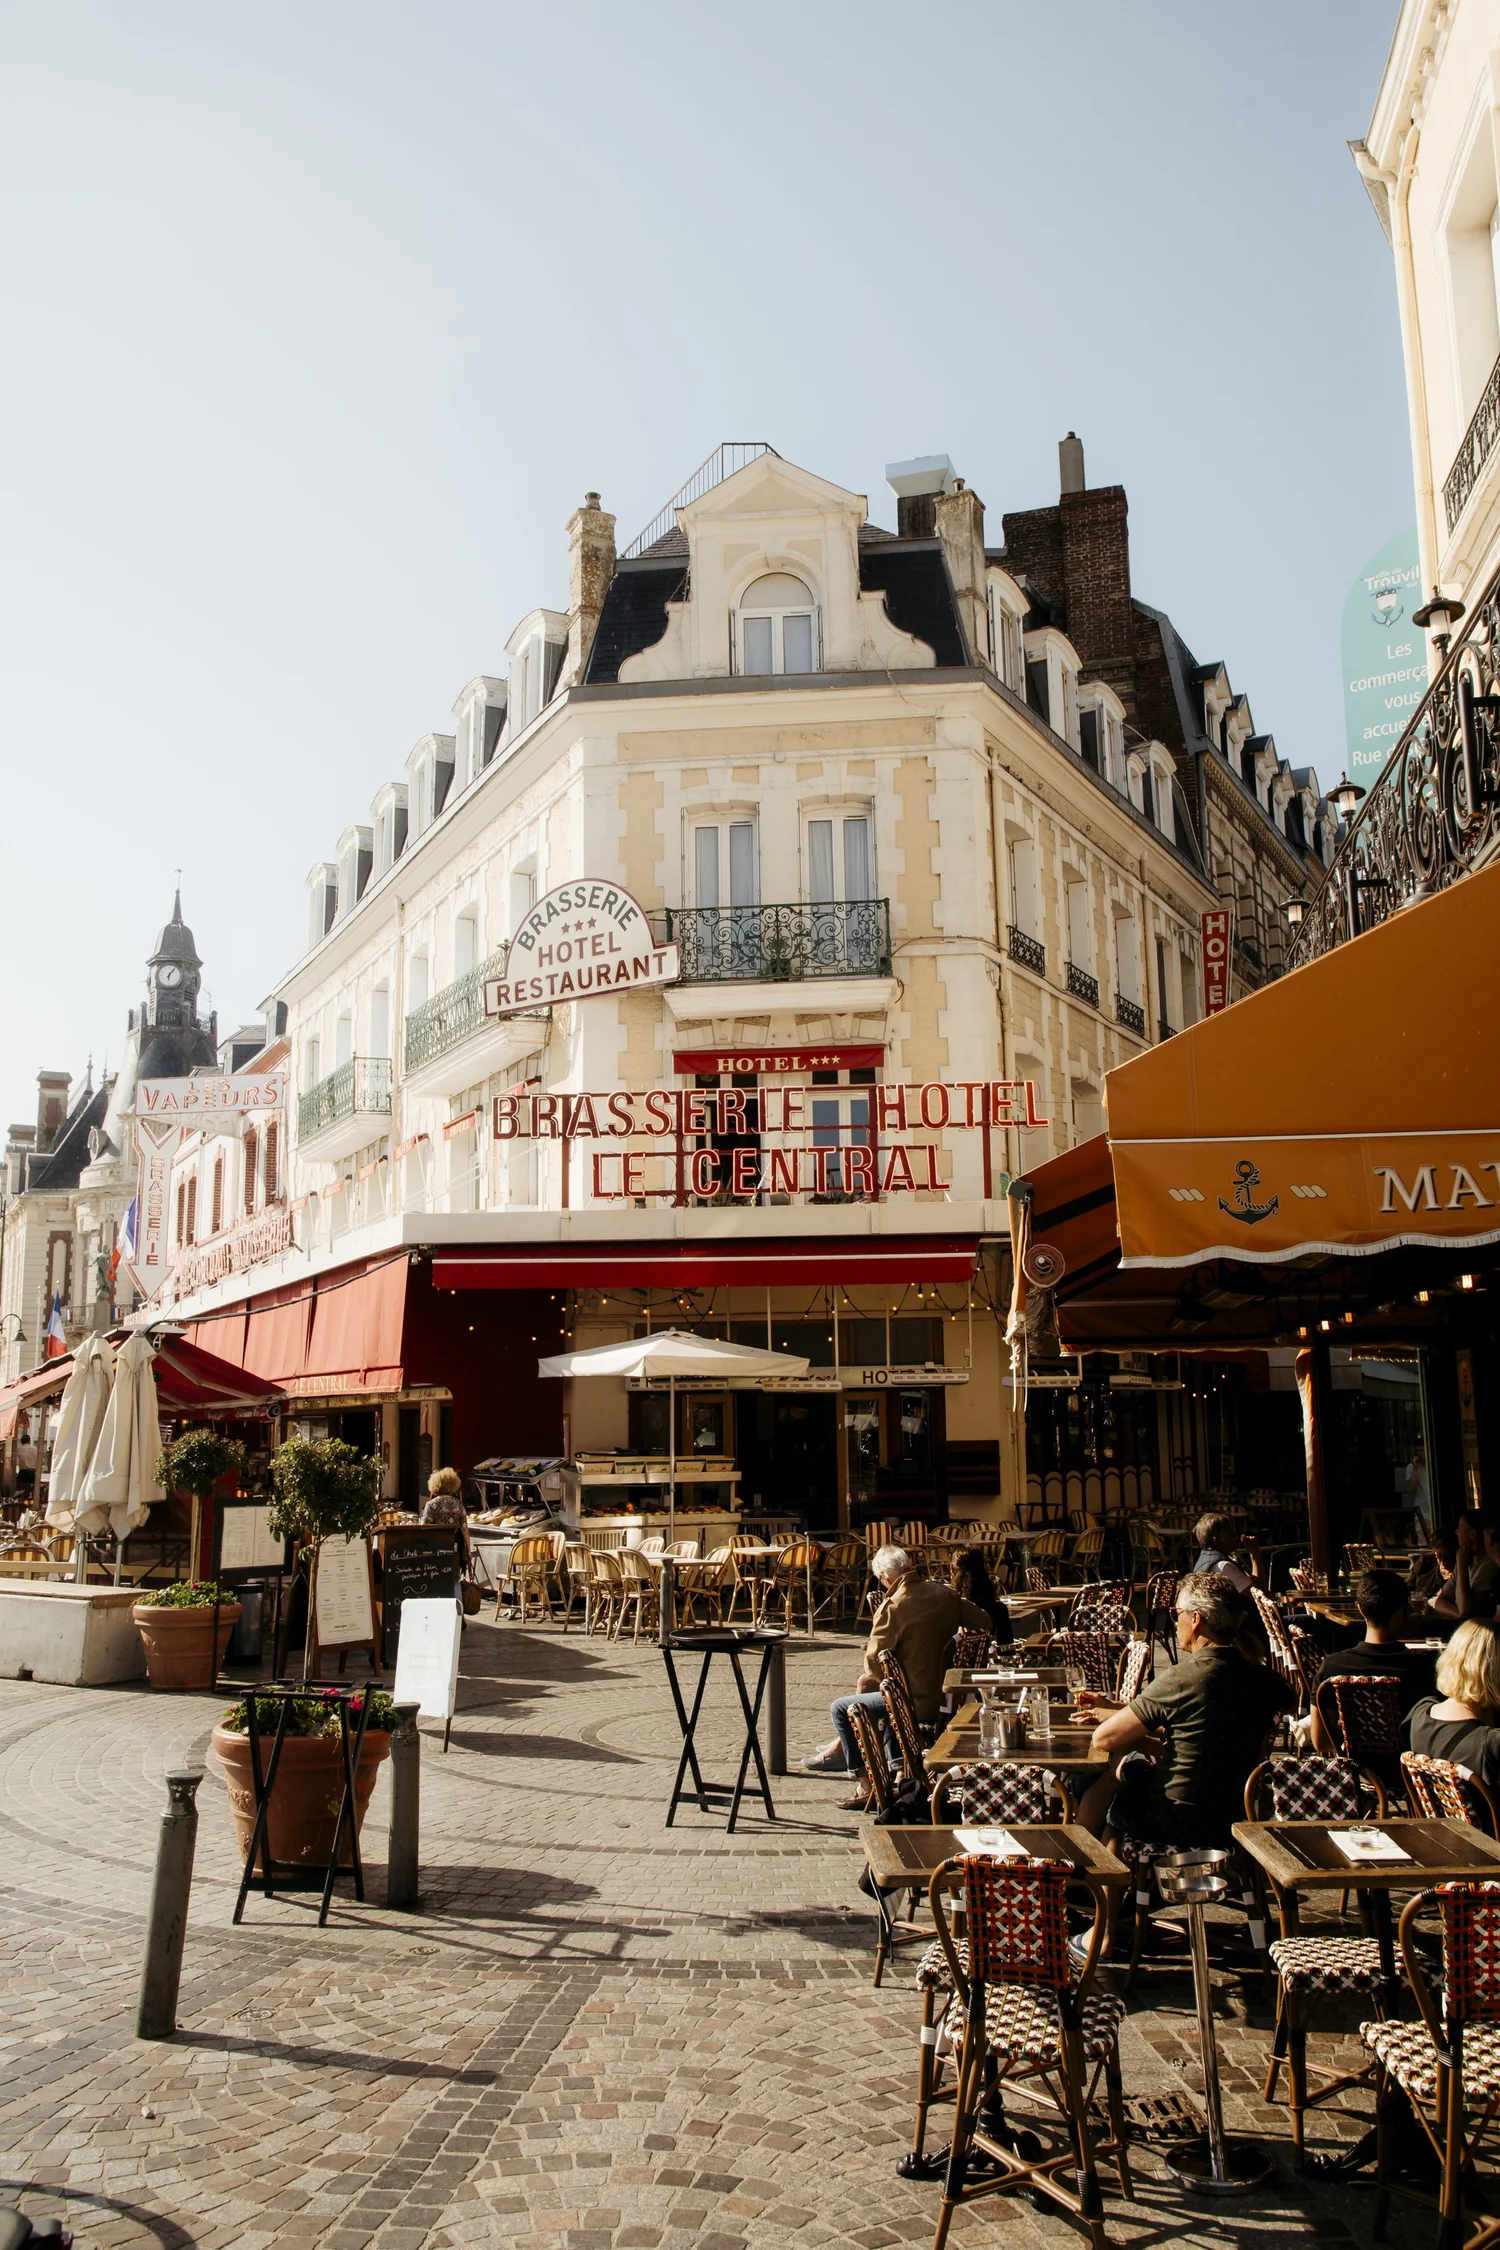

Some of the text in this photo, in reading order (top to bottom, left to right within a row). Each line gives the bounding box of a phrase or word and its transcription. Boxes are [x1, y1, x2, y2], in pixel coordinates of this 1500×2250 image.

[1387, 643, 1412, 660] Les
[1384, 692, 1421, 709] vous
[1352, 750, 1382, 767] Rue
[517, 885, 639, 952] BRASSERIE
[538, 931, 622, 968] HOTEL
[496, 952, 668, 1006] RESTAURANT
[716, 1056, 807, 1073] HOTEL
[141, 1078, 278, 1111] VAPEURS
[188, 1078, 231, 1093] LES
[492, 1085, 806, 1141] BRASSERIE
[876, 1080, 1050, 1134] HOTEL
[591, 1144, 953, 1199] LE CENTRAL
[146, 1155, 165, 1266] BRASSERIE
[307, 1375, 349, 1392] CENTRAL
